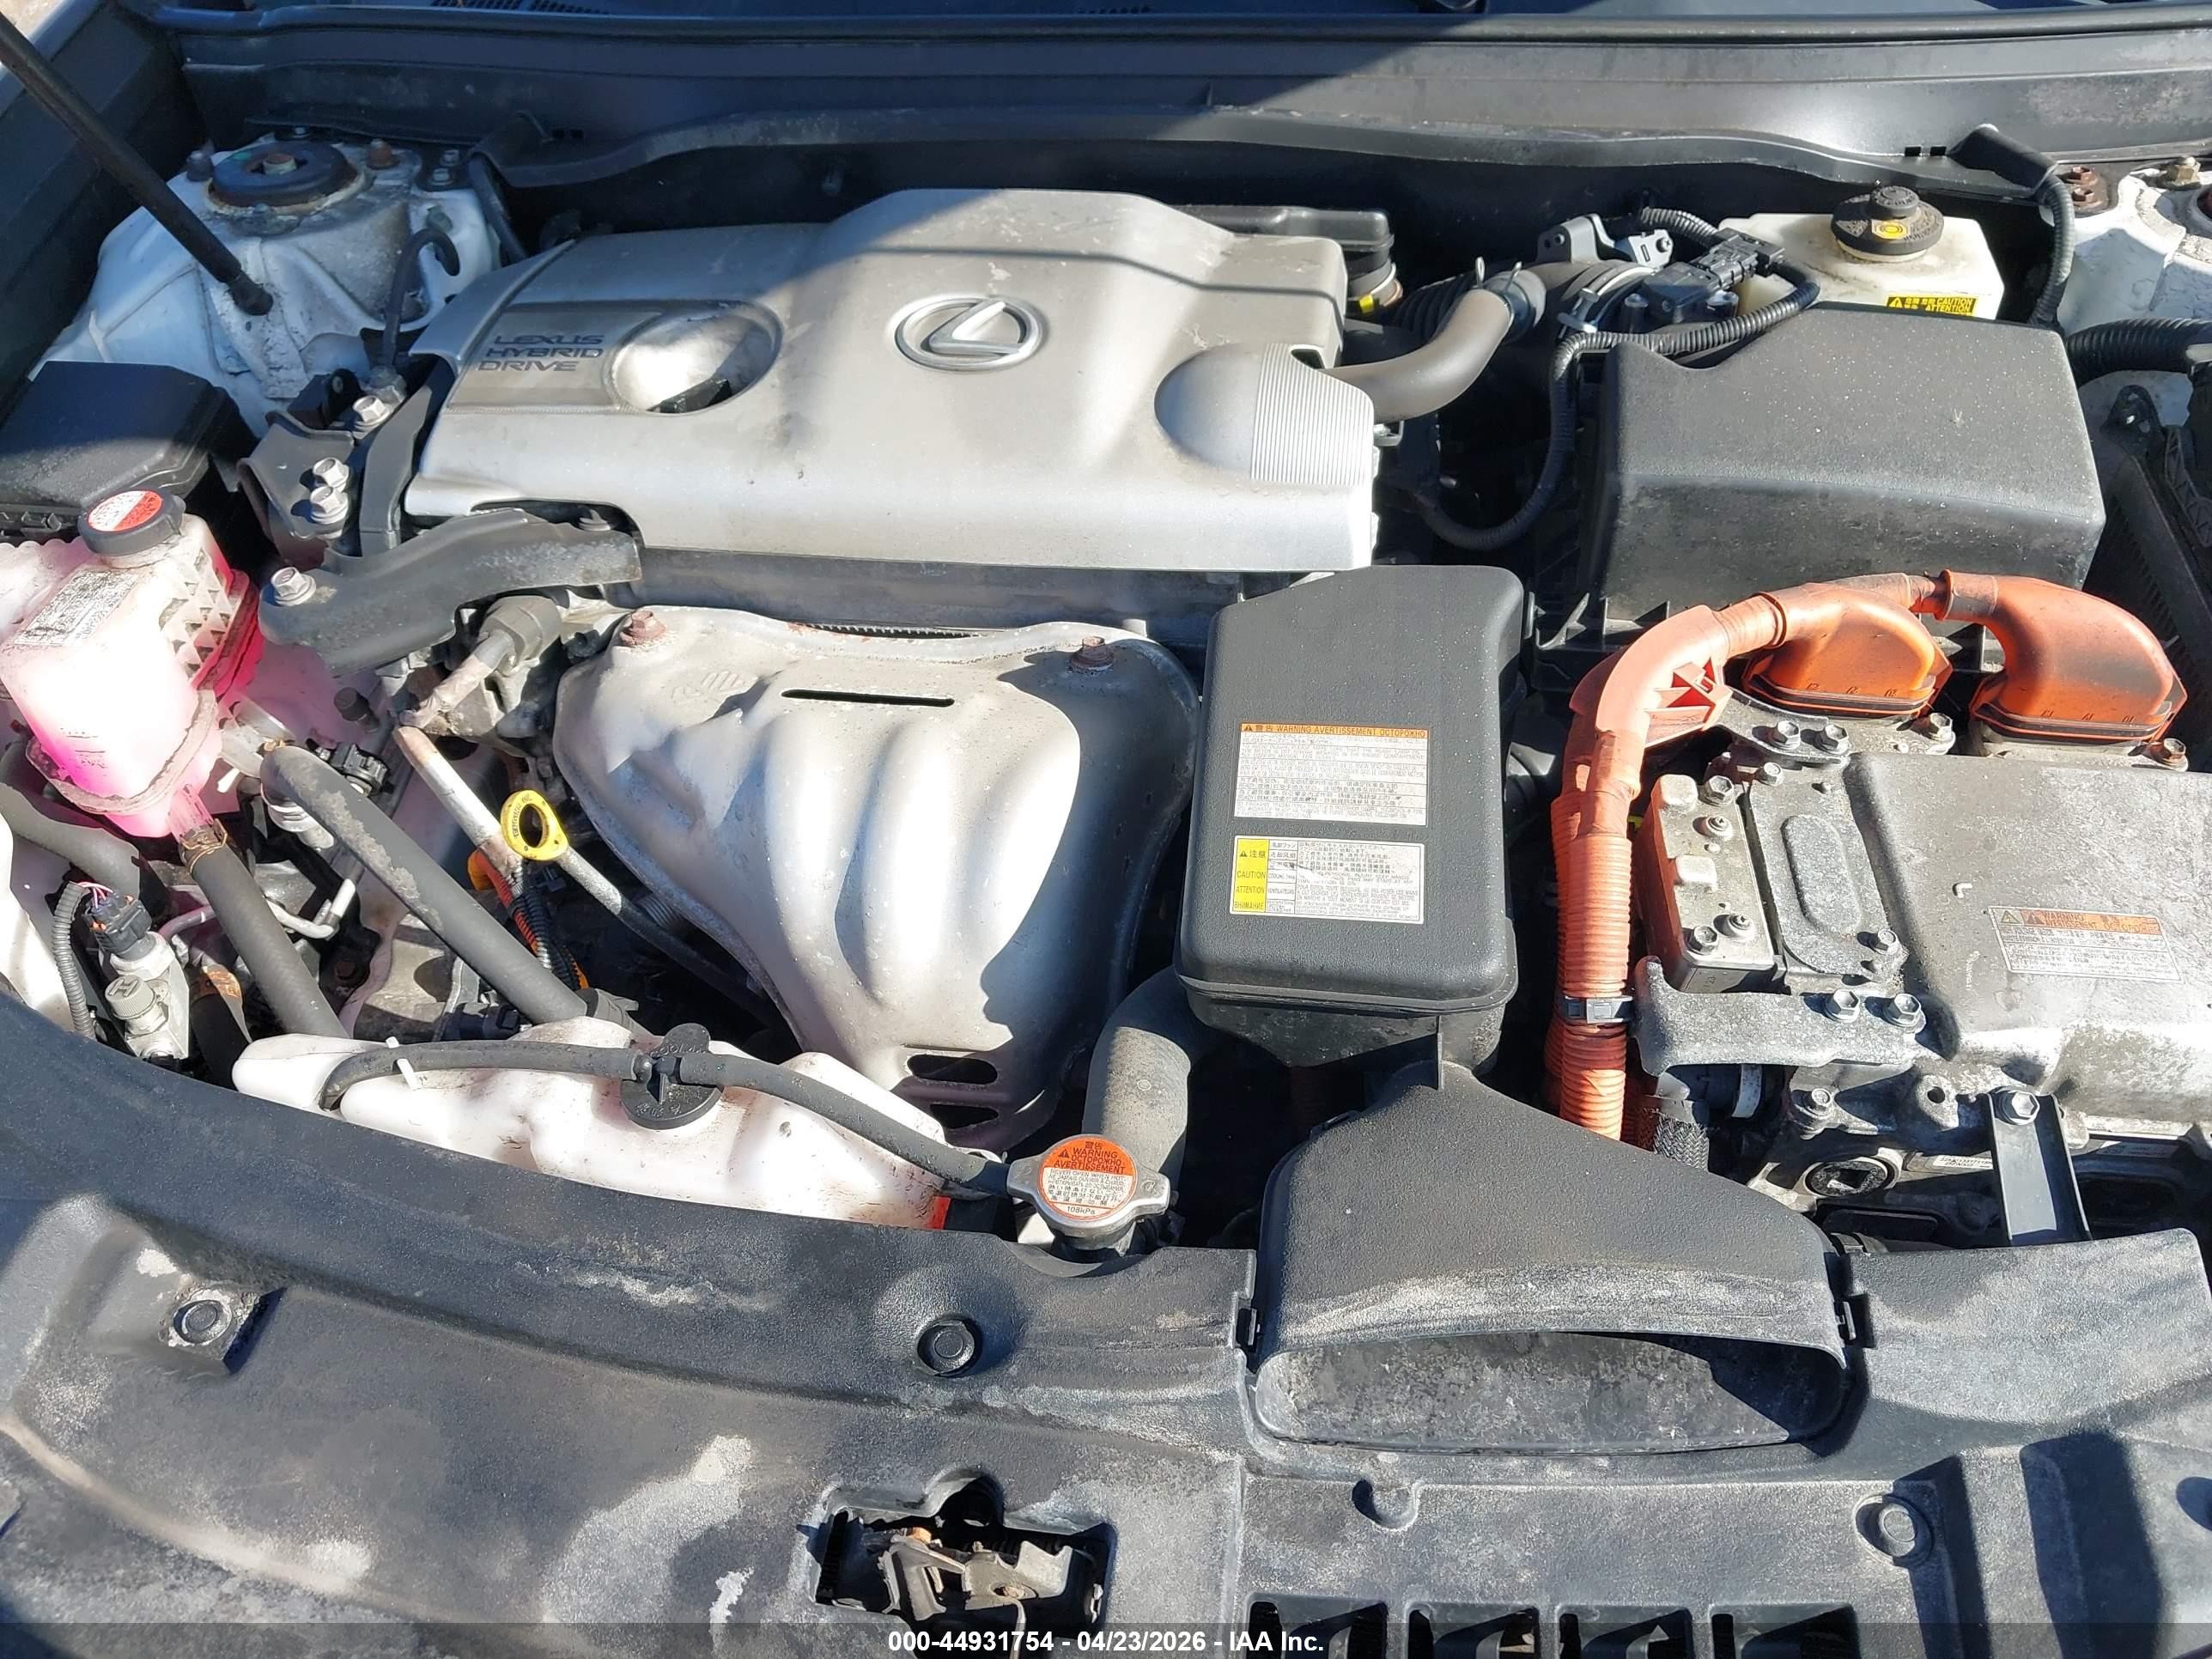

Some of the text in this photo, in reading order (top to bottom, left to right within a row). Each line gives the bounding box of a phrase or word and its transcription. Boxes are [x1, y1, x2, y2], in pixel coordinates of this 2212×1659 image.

[495, 335, 605, 344] LEXUS
[485, 347, 604, 358] HYBRID
[478, 360, 580, 372] DRIVE
[1276, 725, 1312, 733] WARNING
[1315, 726, 1376, 736] AVERTISSEMENT
[1237, 871, 1266, 879] CAUTION
[1235, 885, 1265, 894] ATTENTION
[107, 978, 138, 997] H
[1072, 1147, 1118, 1159] WARNING
[1071, 1154, 1121, 1166] ОСТОРОЖНО
[1054, 1159, 1126, 1175] AVERTISSEMENT
[1066, 1206, 1096, 1215] 108kPa
